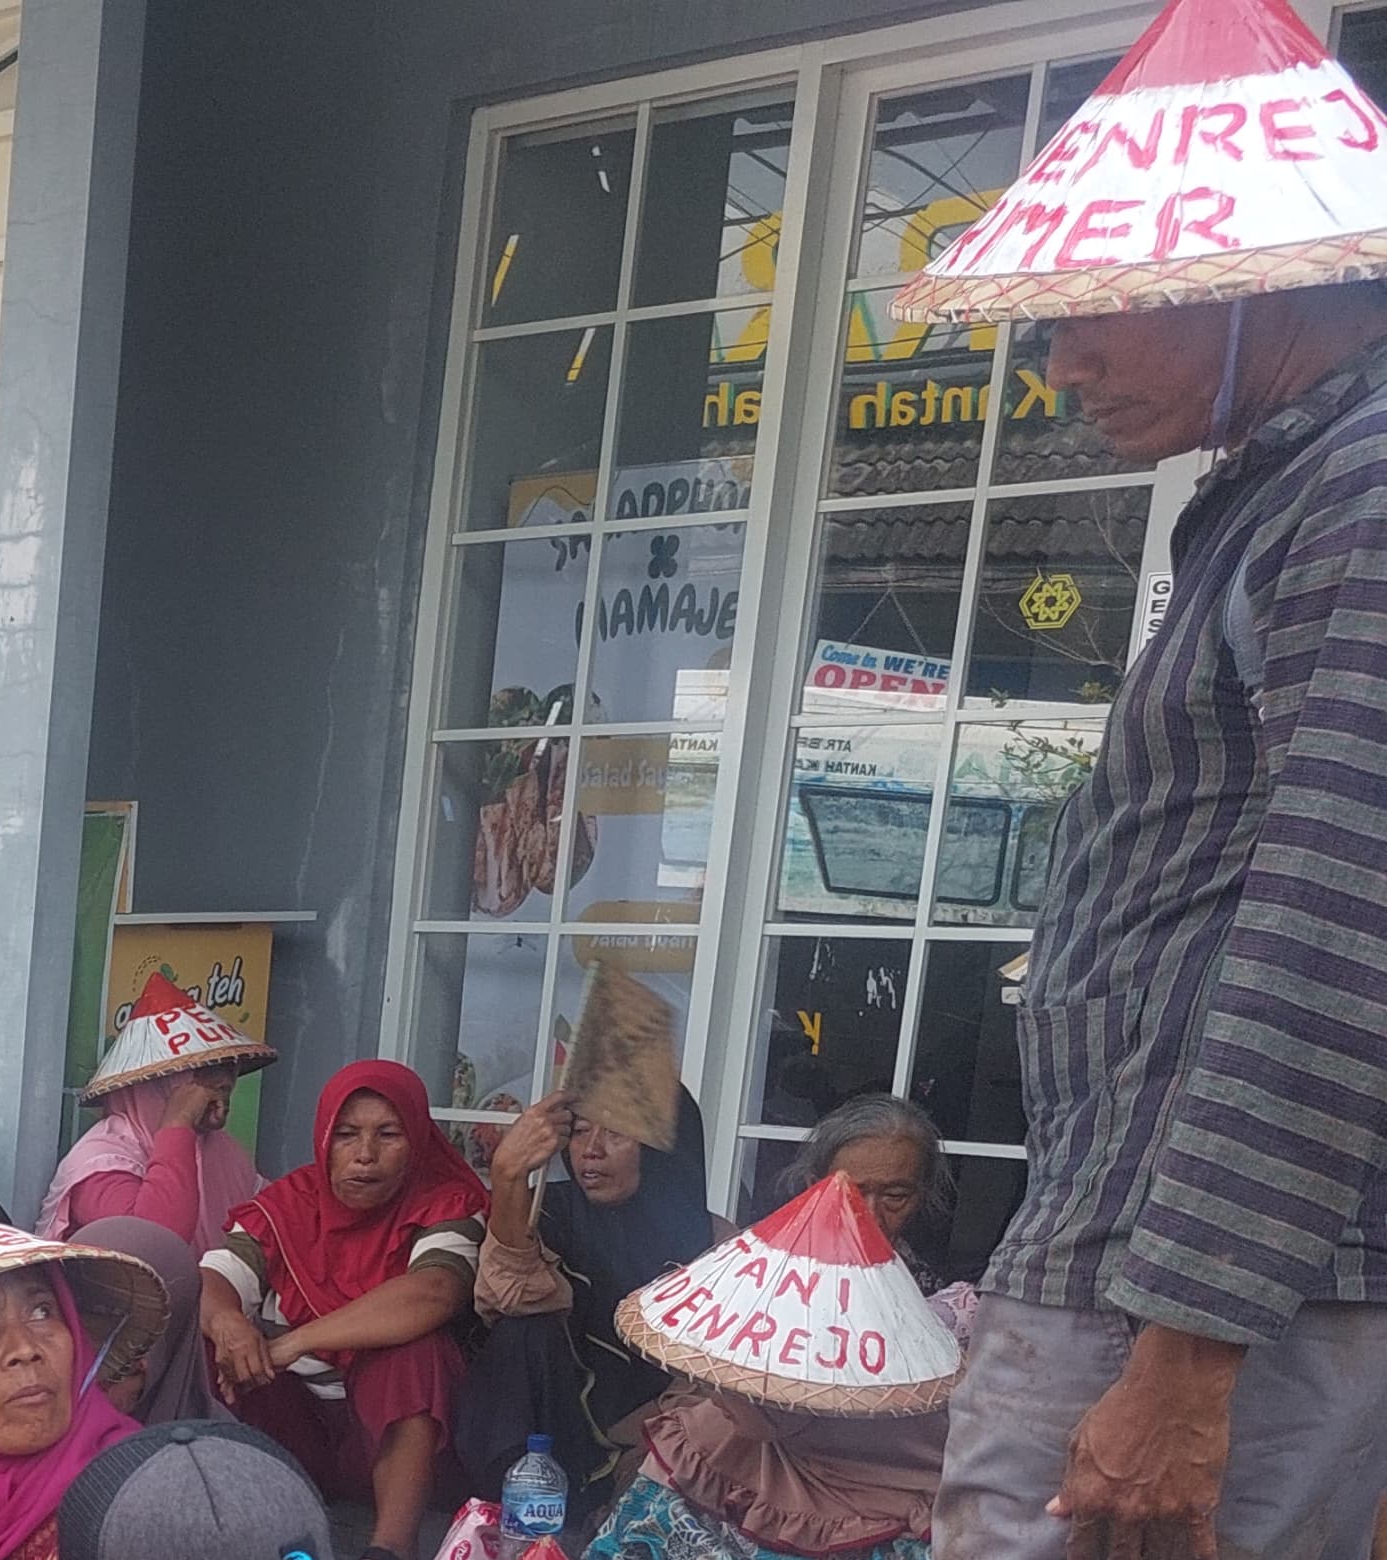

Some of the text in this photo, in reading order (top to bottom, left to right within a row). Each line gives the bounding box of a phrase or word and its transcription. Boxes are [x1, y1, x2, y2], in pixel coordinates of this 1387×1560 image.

[822, 645, 860, 667] Come
[883, 655, 951, 681] WE'RE
[814, 664, 947, 700] OPEN
[207, 956, 245, 1010] teh
[715, 1237, 852, 1314] TANI
[524, 1502, 564, 1521] AQUA
